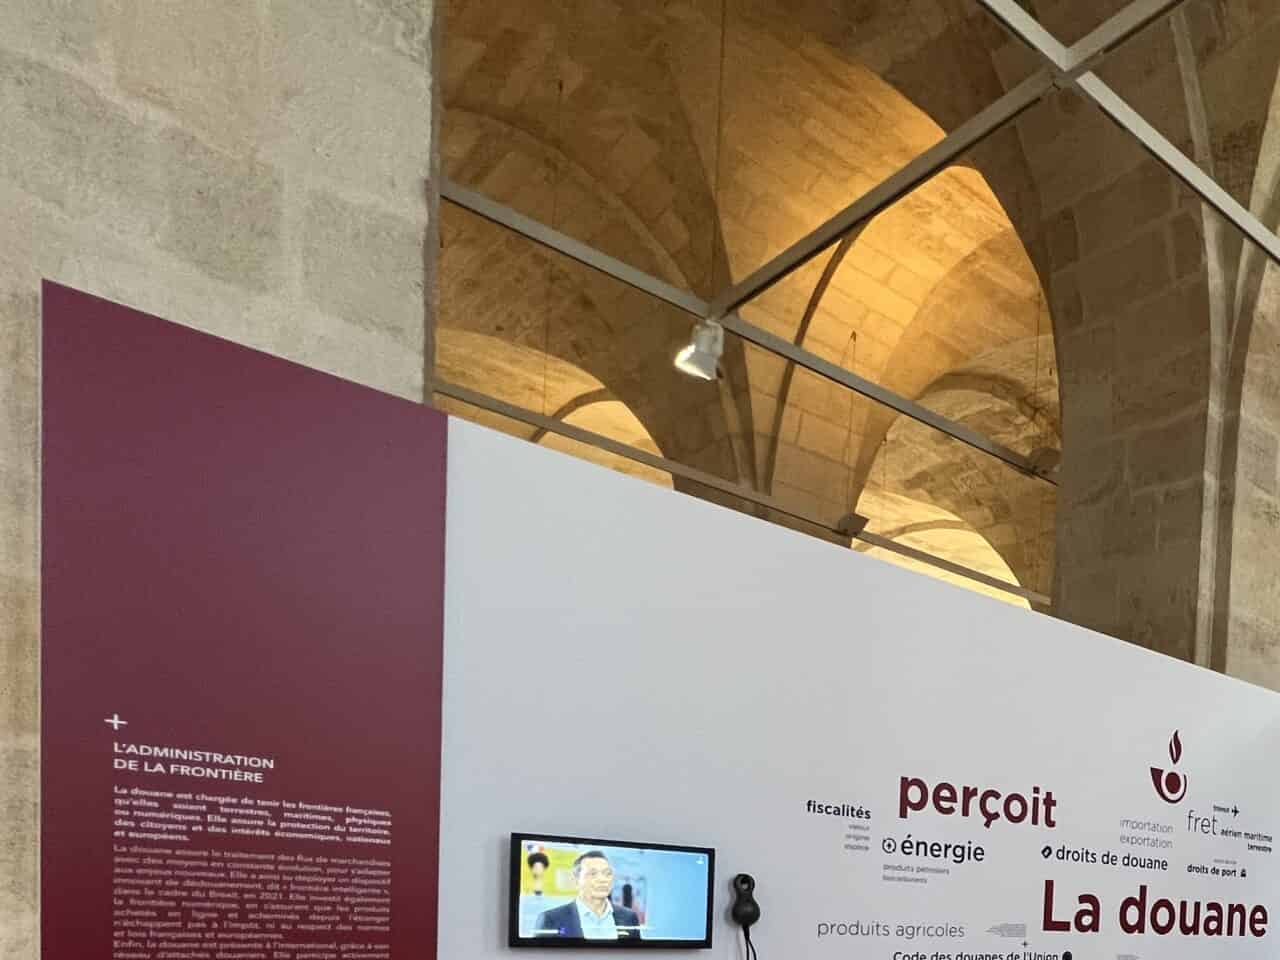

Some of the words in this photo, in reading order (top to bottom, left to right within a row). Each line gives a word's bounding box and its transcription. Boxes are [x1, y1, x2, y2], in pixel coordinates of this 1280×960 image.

[114, 742, 274, 769] L'ADMINISTRATION
[114, 759, 139, 771] DE
[144, 762, 165, 774] LA
[170, 764, 264, 783] FRONTIÈRE
[806, 800, 871, 820] fiscalités
[899, 776, 1056, 828] perçoit
[1120, 818, 1173, 834] importation
[1188, 810, 1217, 835] fret
[901, 834, 984, 863] énergie
[1120, 834, 1173, 848] exportation
[1056, 846, 1096, 864] droits
[1101, 851, 1118, 866] de
[1122, 852, 1168, 871] douane
[1187, 864, 1208, 875] droits
[1210, 866, 1220, 876] de
[1222, 868, 1236, 878] port
[1042, 879, 1100, 933] La
[1119, 884, 1268, 937] douane
[817, 921, 890, 938] produits
[895, 922, 964, 940] agricoles
